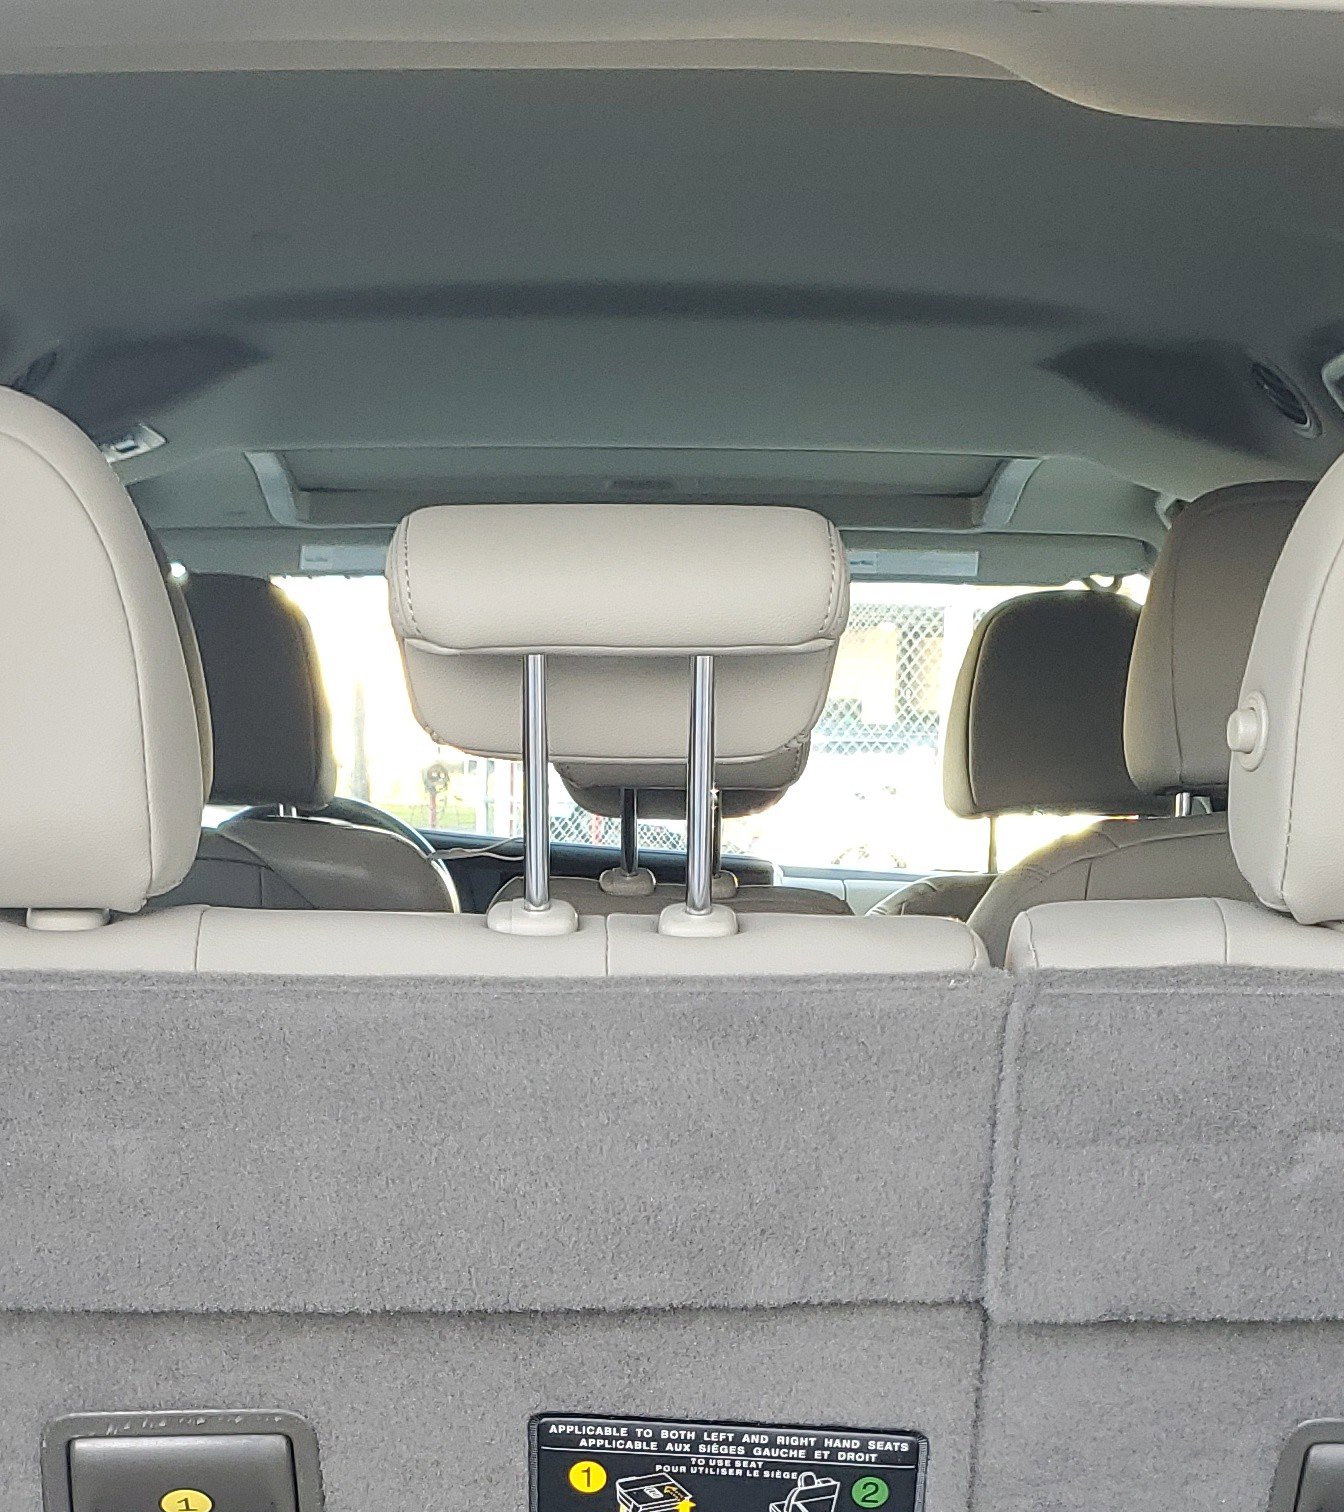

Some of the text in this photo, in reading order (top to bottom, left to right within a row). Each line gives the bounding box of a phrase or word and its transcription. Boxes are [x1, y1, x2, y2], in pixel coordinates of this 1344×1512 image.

[549, 1425, 909, 1451] APPLICABLE TO BOTH LEFT AND RIGHT HAND SEATS
[579, 1438, 658, 1450] APPLICABLE
[665, 1443, 690, 1452] AUX
[753, 1446, 806, 1458] GAUCHE
[814, 1450, 830, 1460] ET
[838, 1452, 878, 1462] DROIT
[655, 1464, 687, 1473] POUR
[690, 1466, 743, 1477] UTILISER
[746, 1469, 760, 1477] LE
[709, 1459, 732, 1467] USE
[735, 1460, 764, 1469] SEAT
[861, 1481, 880, 1504] 2
